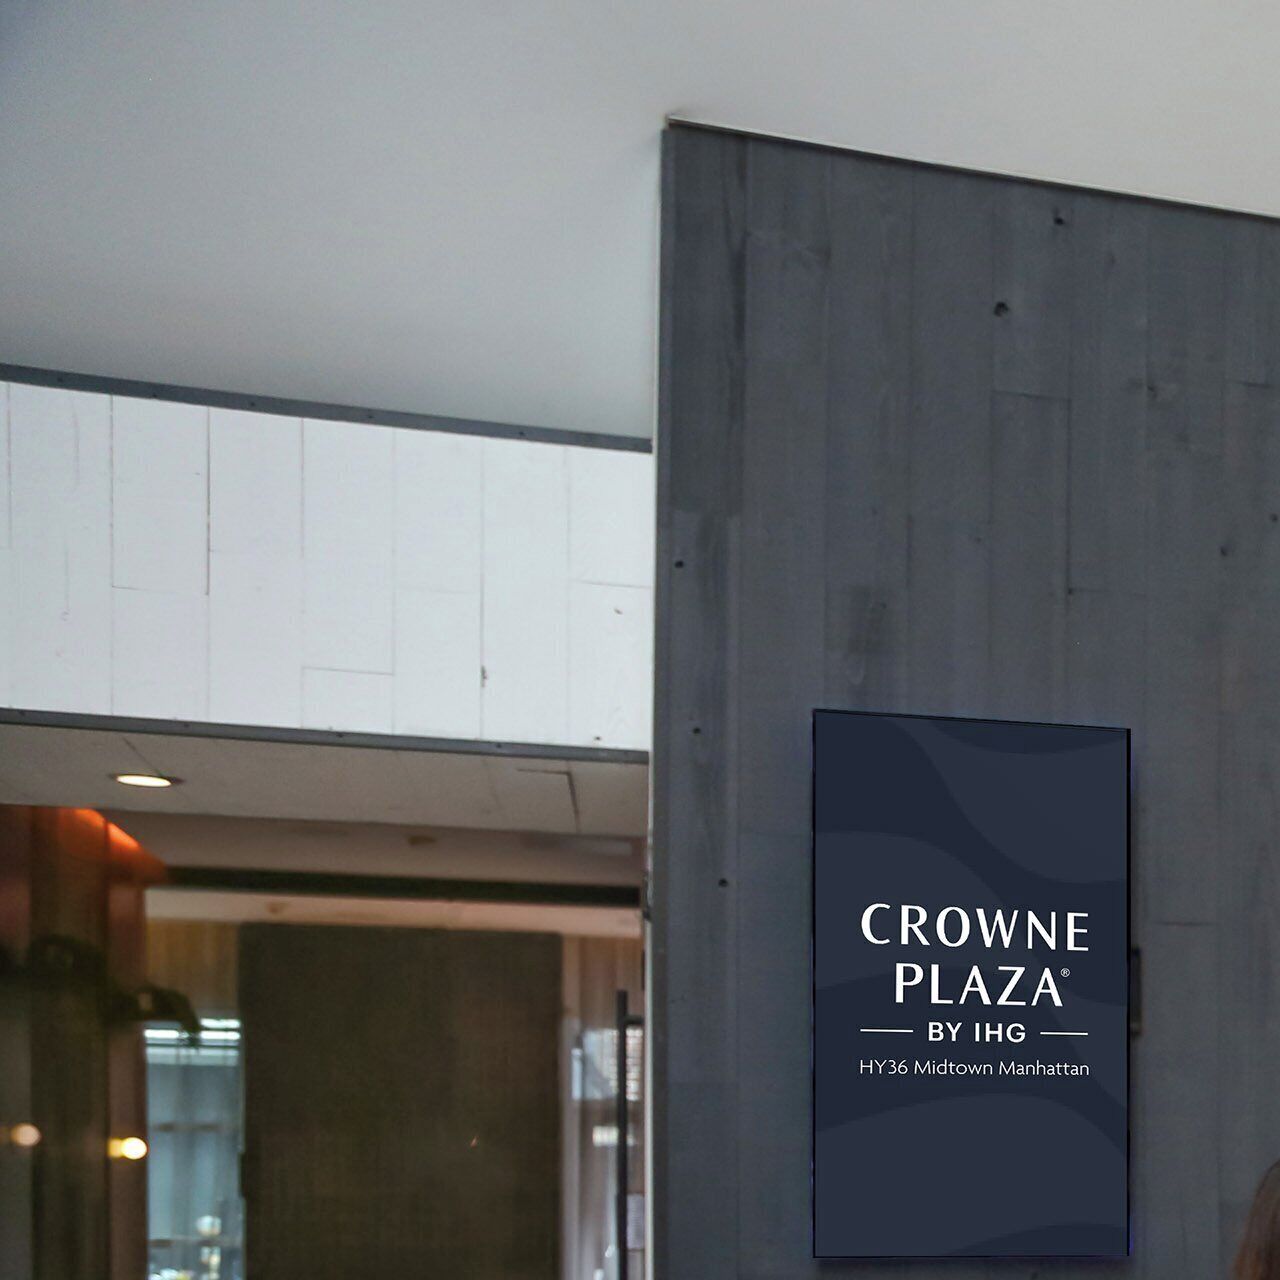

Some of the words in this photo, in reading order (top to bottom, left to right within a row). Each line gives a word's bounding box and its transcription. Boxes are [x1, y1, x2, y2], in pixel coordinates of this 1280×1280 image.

[860, 902, 1089, 952] CROWNE
[928, 1021, 963, 1042] BY
[974, 1022, 1026, 1043] IHG
[859, 1059, 909, 1076] HY36
[914, 1058, 993, 1076] Midtown
[998, 1059, 1090, 1077] Manhattan
